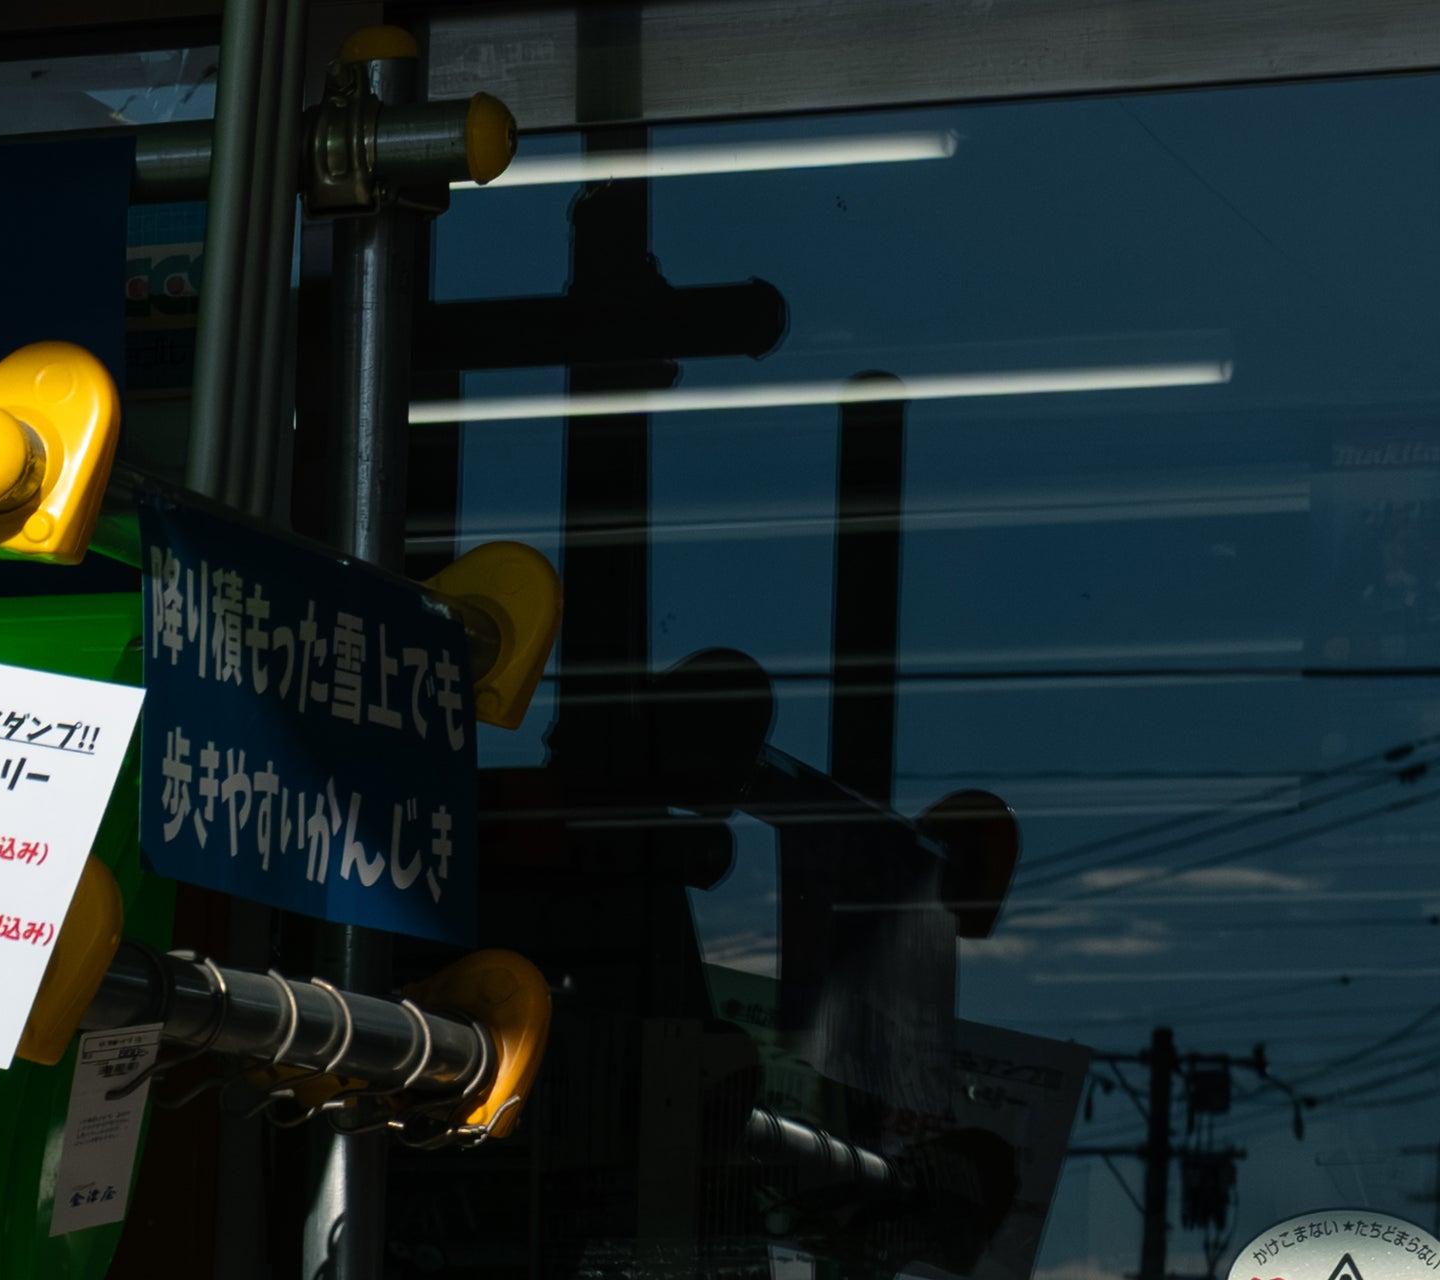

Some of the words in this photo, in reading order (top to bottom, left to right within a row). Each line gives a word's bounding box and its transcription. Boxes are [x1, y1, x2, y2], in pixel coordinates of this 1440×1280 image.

[150, 545, 465, 751] 降り積もった雪上でも
[161, 726, 453, 905] 歩きやすいかんじき
